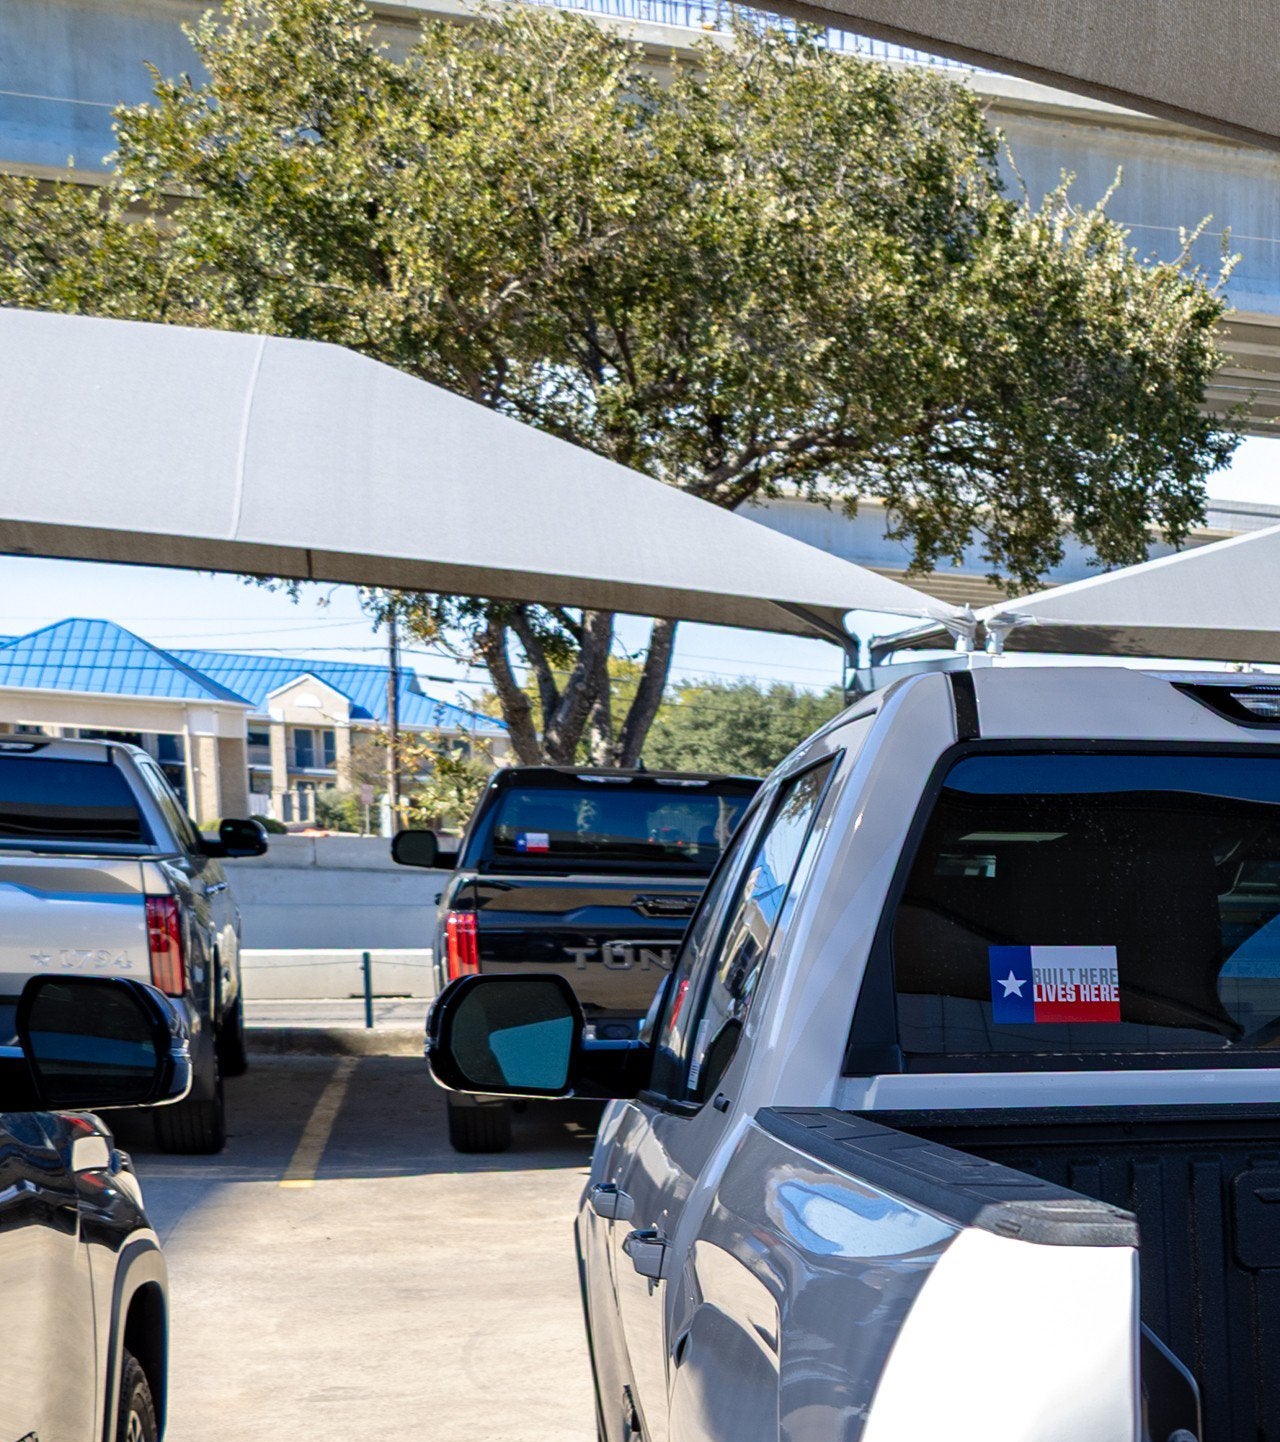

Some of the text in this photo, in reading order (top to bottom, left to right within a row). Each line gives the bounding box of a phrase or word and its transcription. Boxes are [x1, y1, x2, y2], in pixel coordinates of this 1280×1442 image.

[563, 944, 676, 970] TUN
[1033, 968, 1118, 985] BUILT HERE
[1034, 984, 1119, 1002] LIVES HERE
